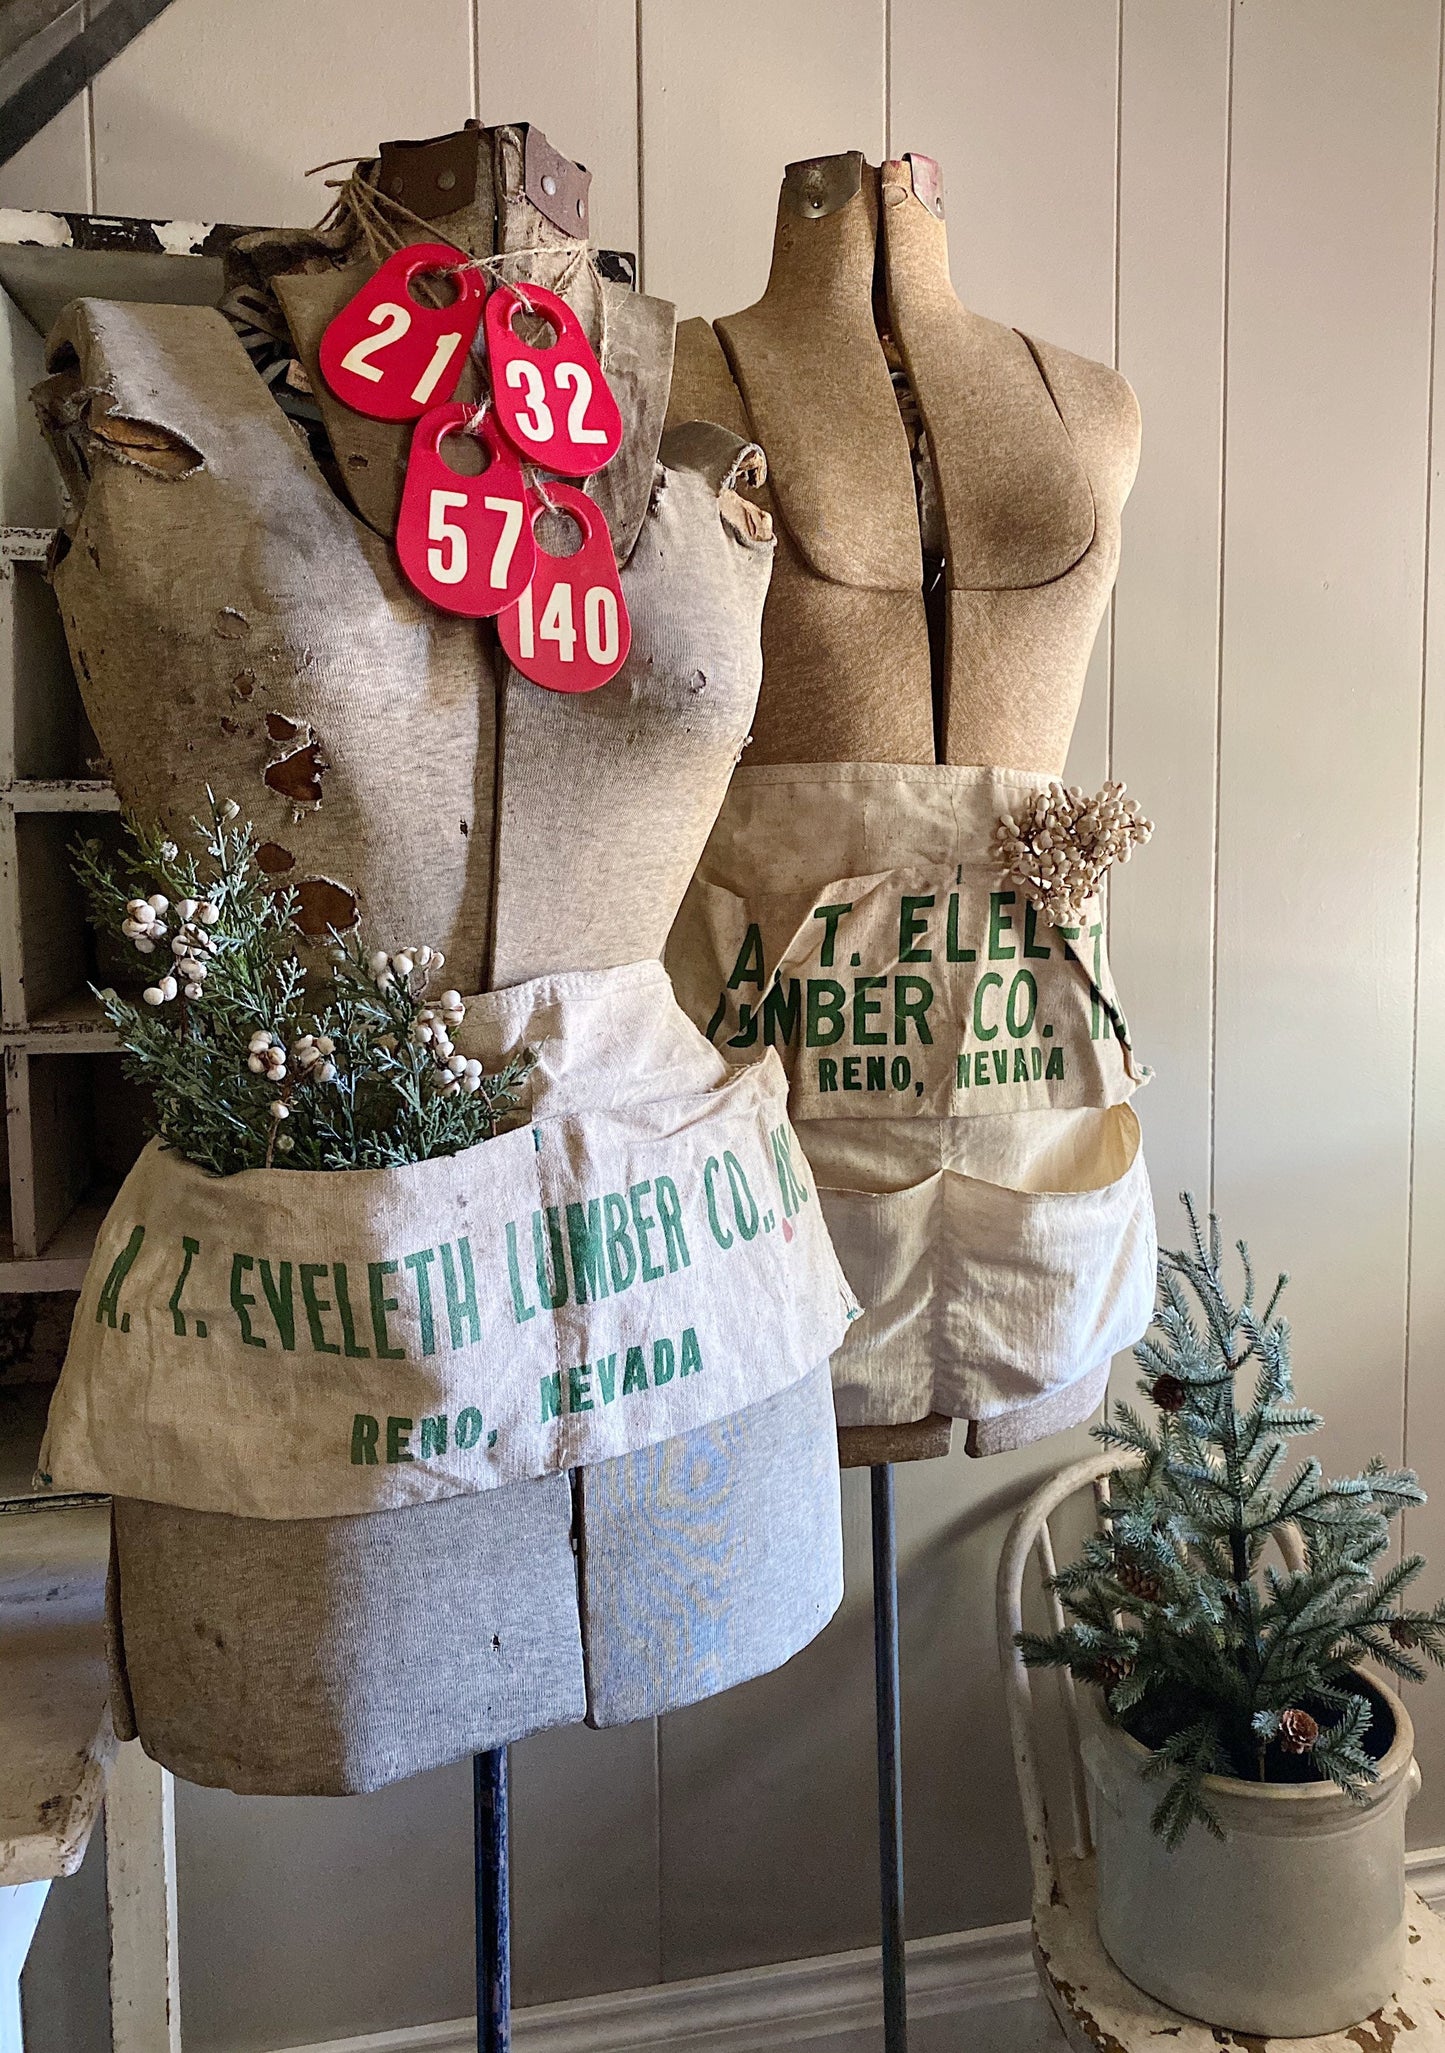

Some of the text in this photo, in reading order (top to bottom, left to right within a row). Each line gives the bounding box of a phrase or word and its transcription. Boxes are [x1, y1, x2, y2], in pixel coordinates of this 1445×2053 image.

[341, 302, 462, 404] 21
[505, 359, 608, 444] 32
[427, 489, 524, 590] 57
[516, 582, 619, 665] 140
[814, 902, 861, 968] T.
[973, 969, 1054, 1041] CO.
[818, 1047, 1065, 1097] RENO, NEVADA
[95, 1225, 145, 1333] A.
[169, 1236, 208, 1338] T.
[230, 1236, 482, 1360] EVELETH
[505, 1175, 692, 1324] LUMBER
[350, 1327, 704, 1465] RENO, NEVADA
